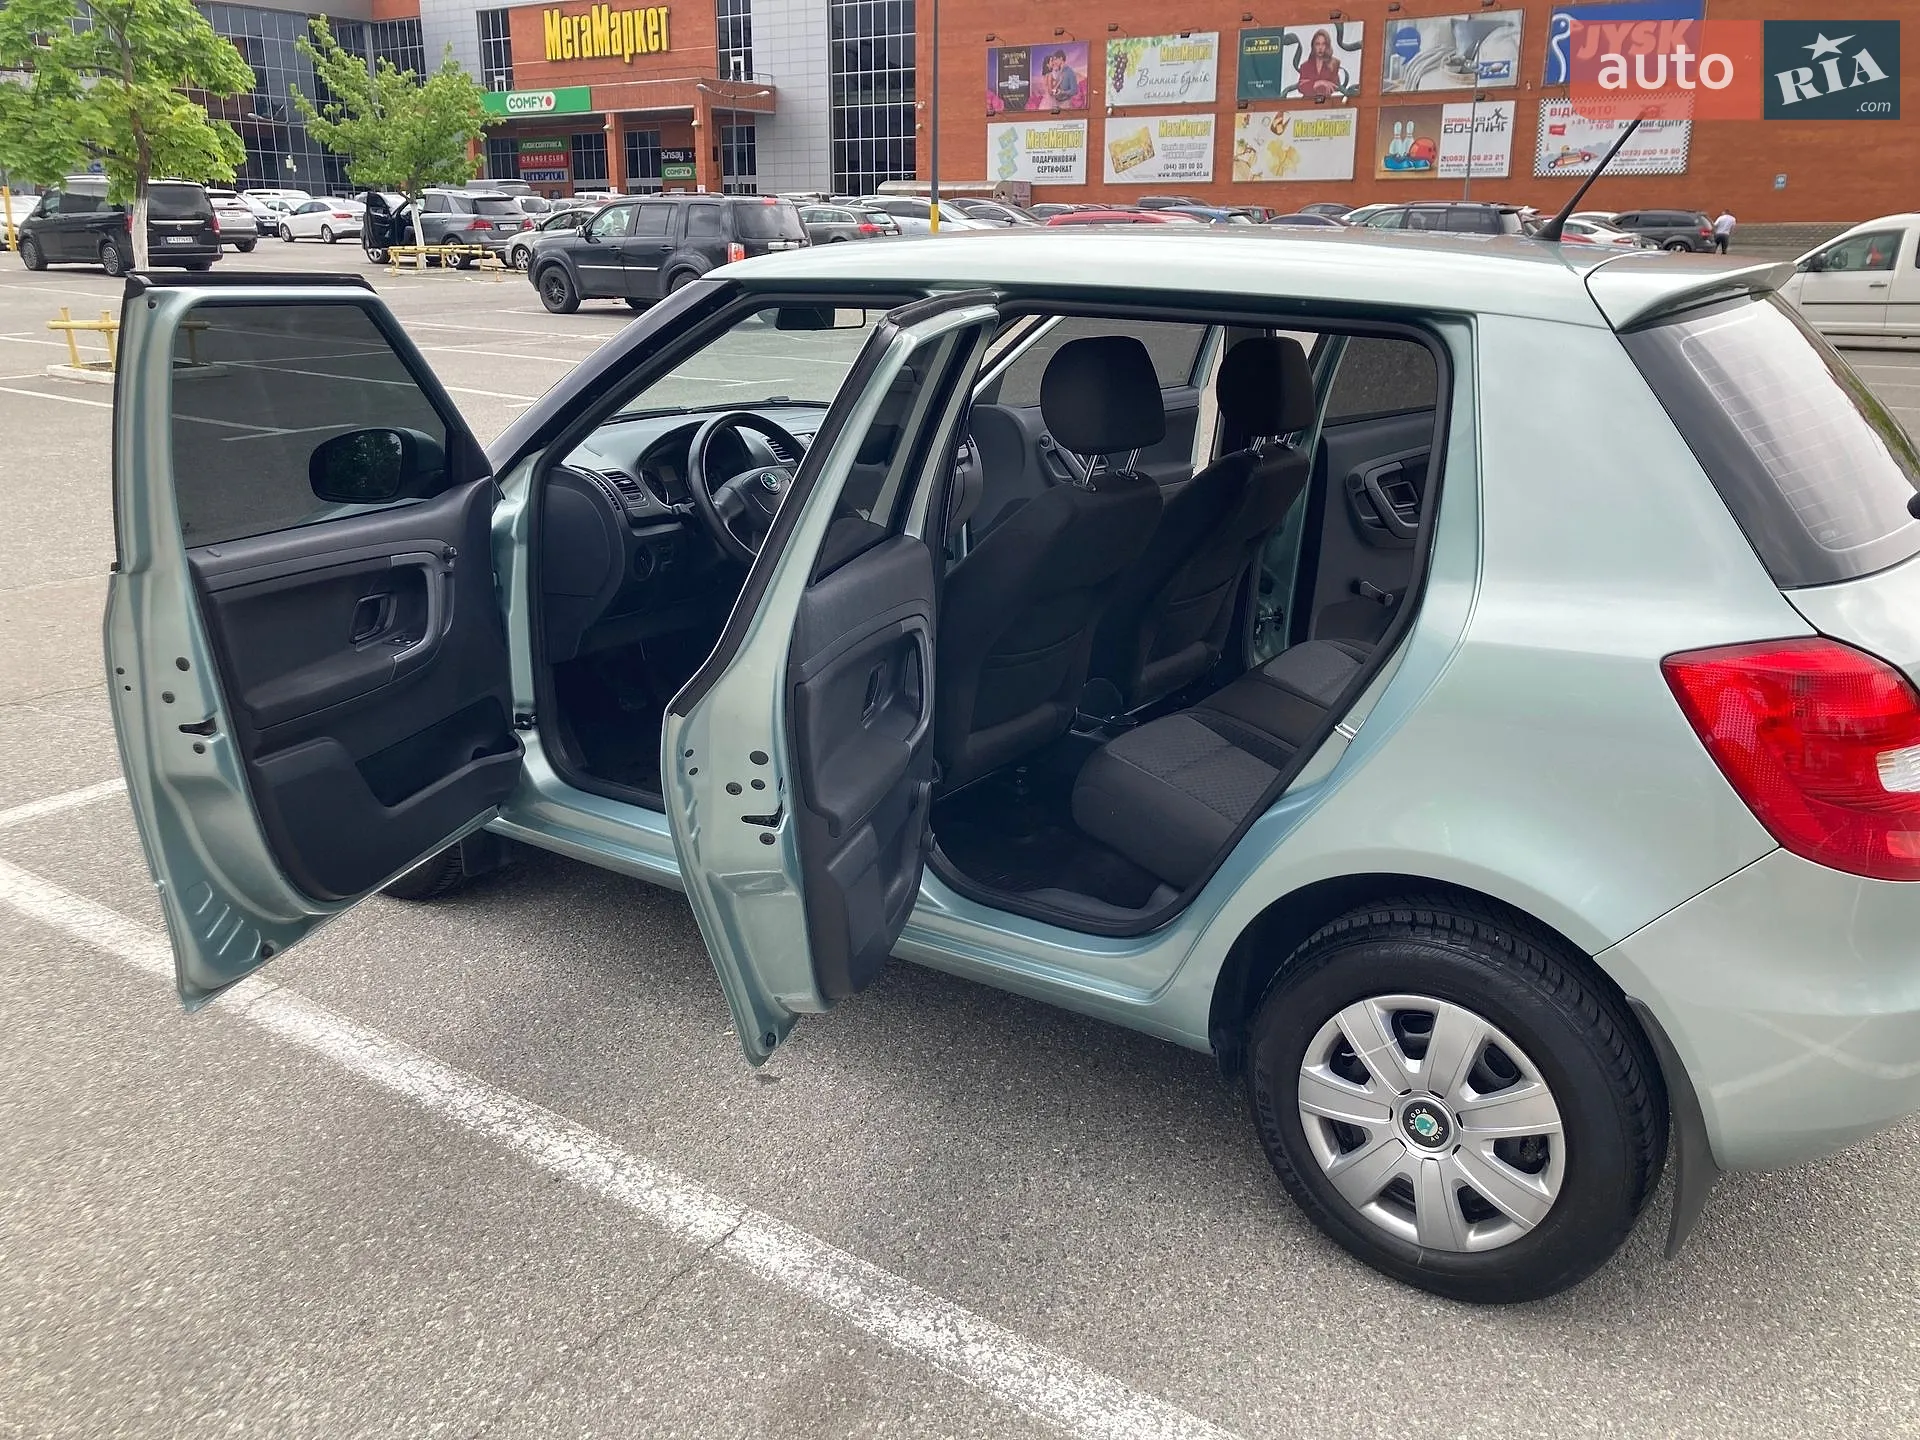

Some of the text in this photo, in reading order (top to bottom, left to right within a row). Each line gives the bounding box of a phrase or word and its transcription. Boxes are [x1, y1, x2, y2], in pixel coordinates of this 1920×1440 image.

[543, 3, 668, 64] МегаМаркет
[1577, 18, 1695, 59] JYSK
[508, 95, 545, 110] COMFY
[1618, 119, 1684, 130] КАИНГ-ЦЕНТР
[1025, 128, 1083, 151] МегаМаркет
[660, 149, 684, 161] sinsay
[1037, 165, 1073, 173] СЕРТИФІКАТ
[1430, 1126, 1444, 1142] AUTO
